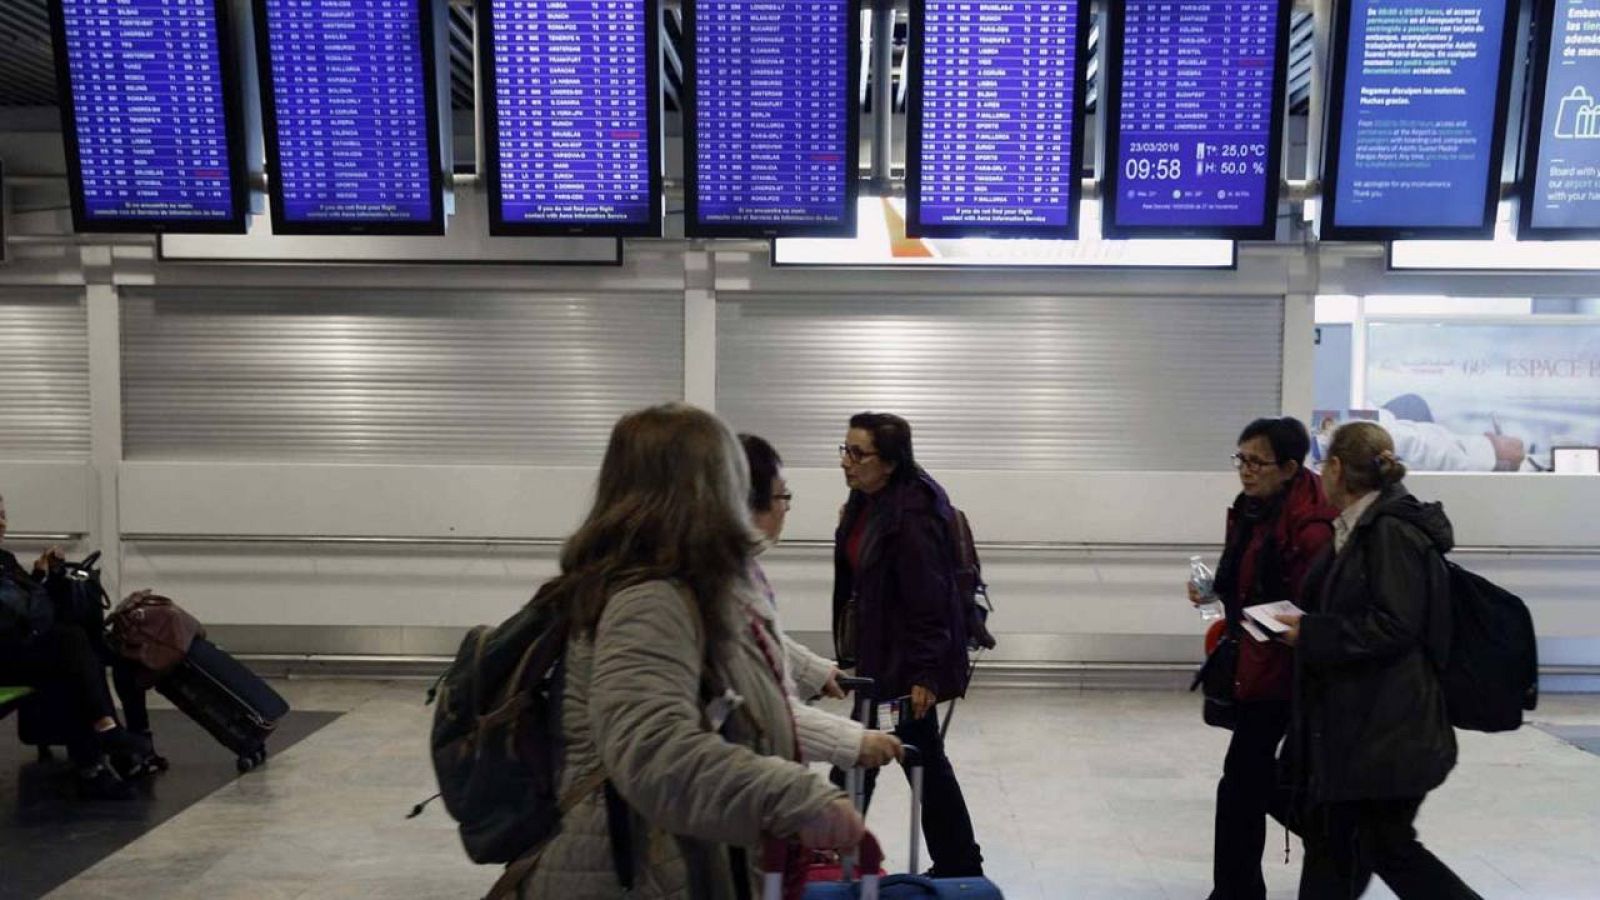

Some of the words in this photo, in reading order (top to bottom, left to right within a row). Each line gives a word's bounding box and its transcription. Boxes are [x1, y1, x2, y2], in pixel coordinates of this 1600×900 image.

[1130, 143, 1179, 152] 23/03/2016
[1222, 145, 1248, 158] 25,0
[1125, 159, 1180, 179] 09:58
[1221, 163, 1246, 175] 50,0
[1253, 163, 1264, 174] %
